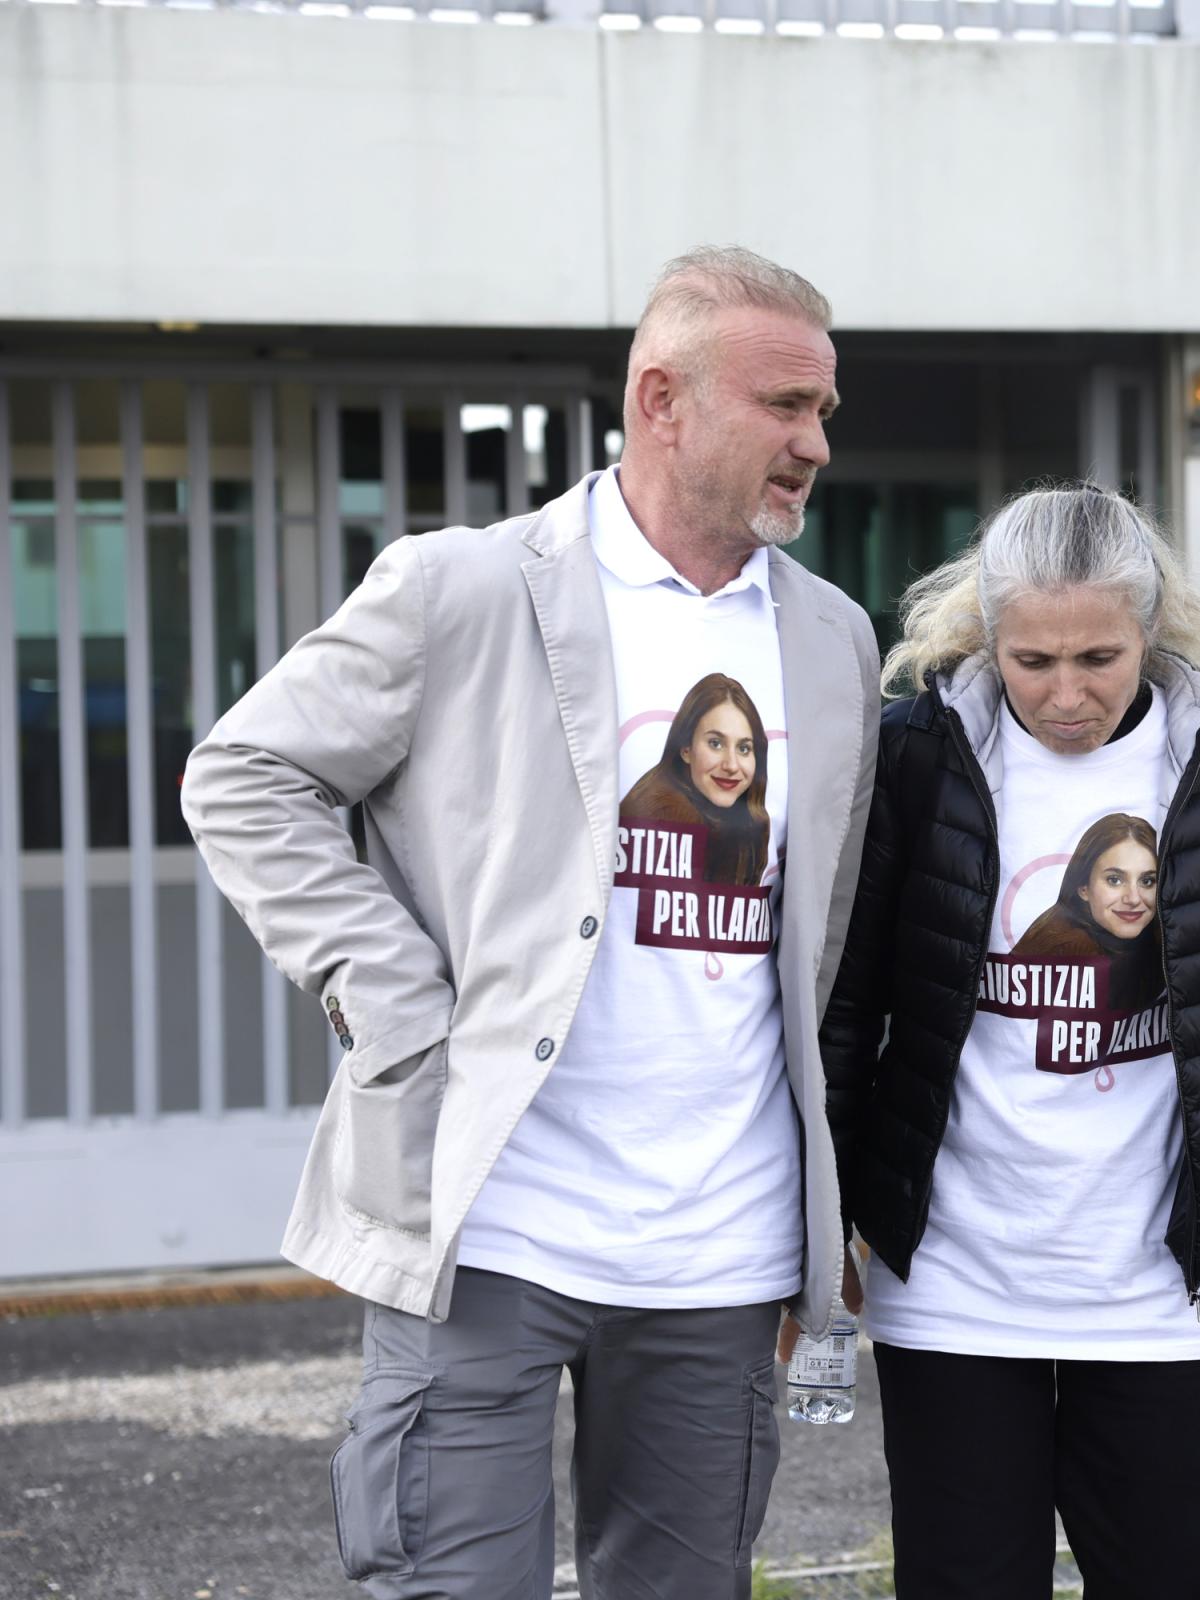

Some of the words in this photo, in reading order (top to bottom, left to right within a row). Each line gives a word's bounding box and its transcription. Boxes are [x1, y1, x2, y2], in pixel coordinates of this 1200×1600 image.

[653, 889, 701, 938] PER
[708, 894, 770, 942] ILARIA
[1051, 1020, 1101, 1063] PER
